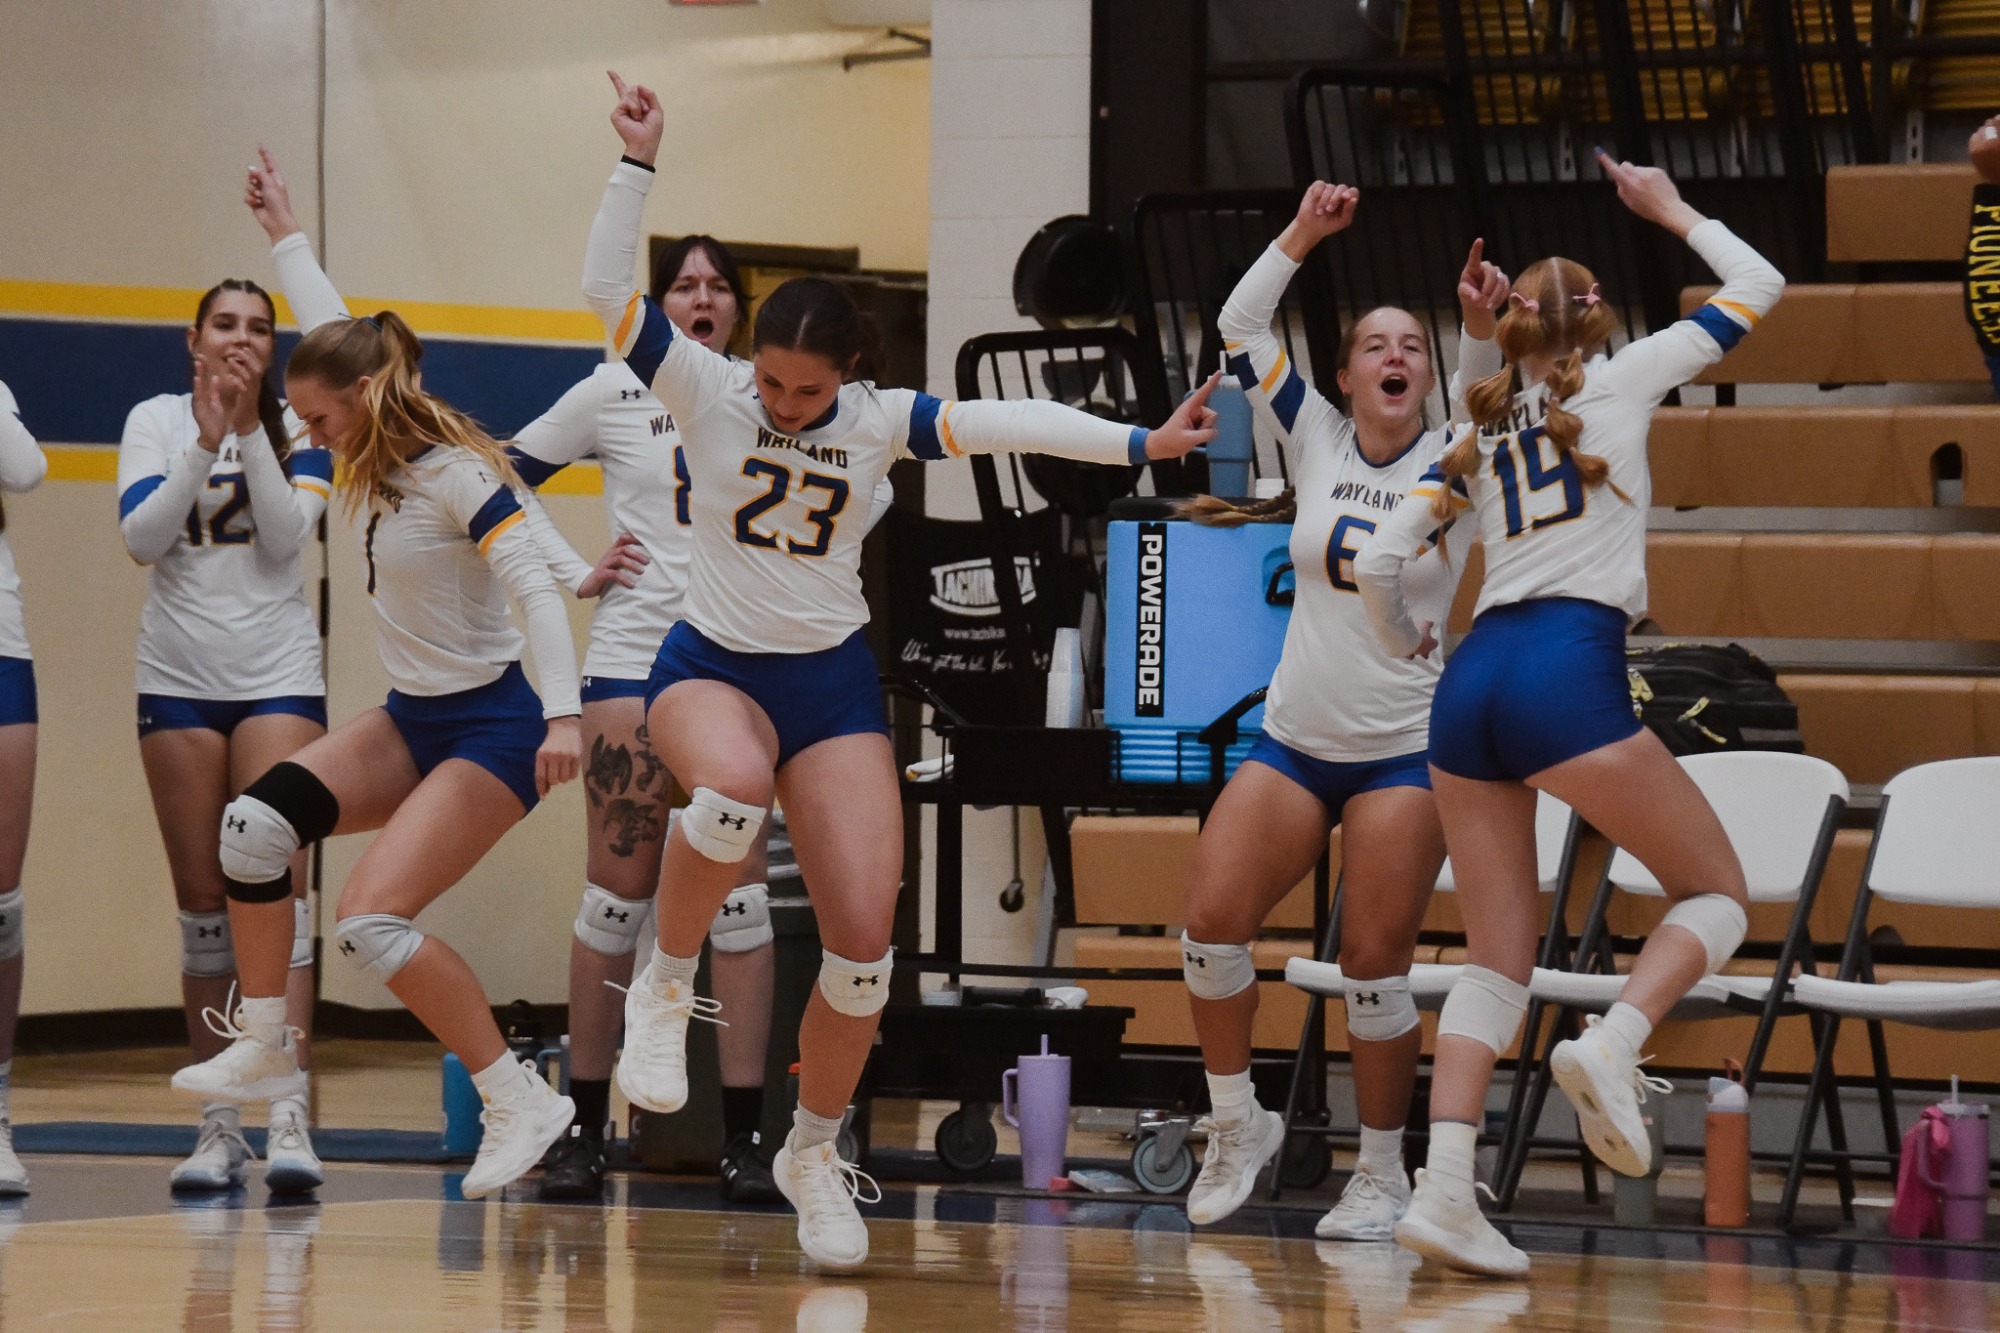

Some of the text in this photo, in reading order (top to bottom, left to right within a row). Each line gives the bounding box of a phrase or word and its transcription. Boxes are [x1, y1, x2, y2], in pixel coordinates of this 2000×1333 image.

[185, 471, 253, 547] 12
[733, 455, 851, 559] 23
[1491, 425, 1588, 541] 19
[1139, 534, 1163, 706] POWERADE
